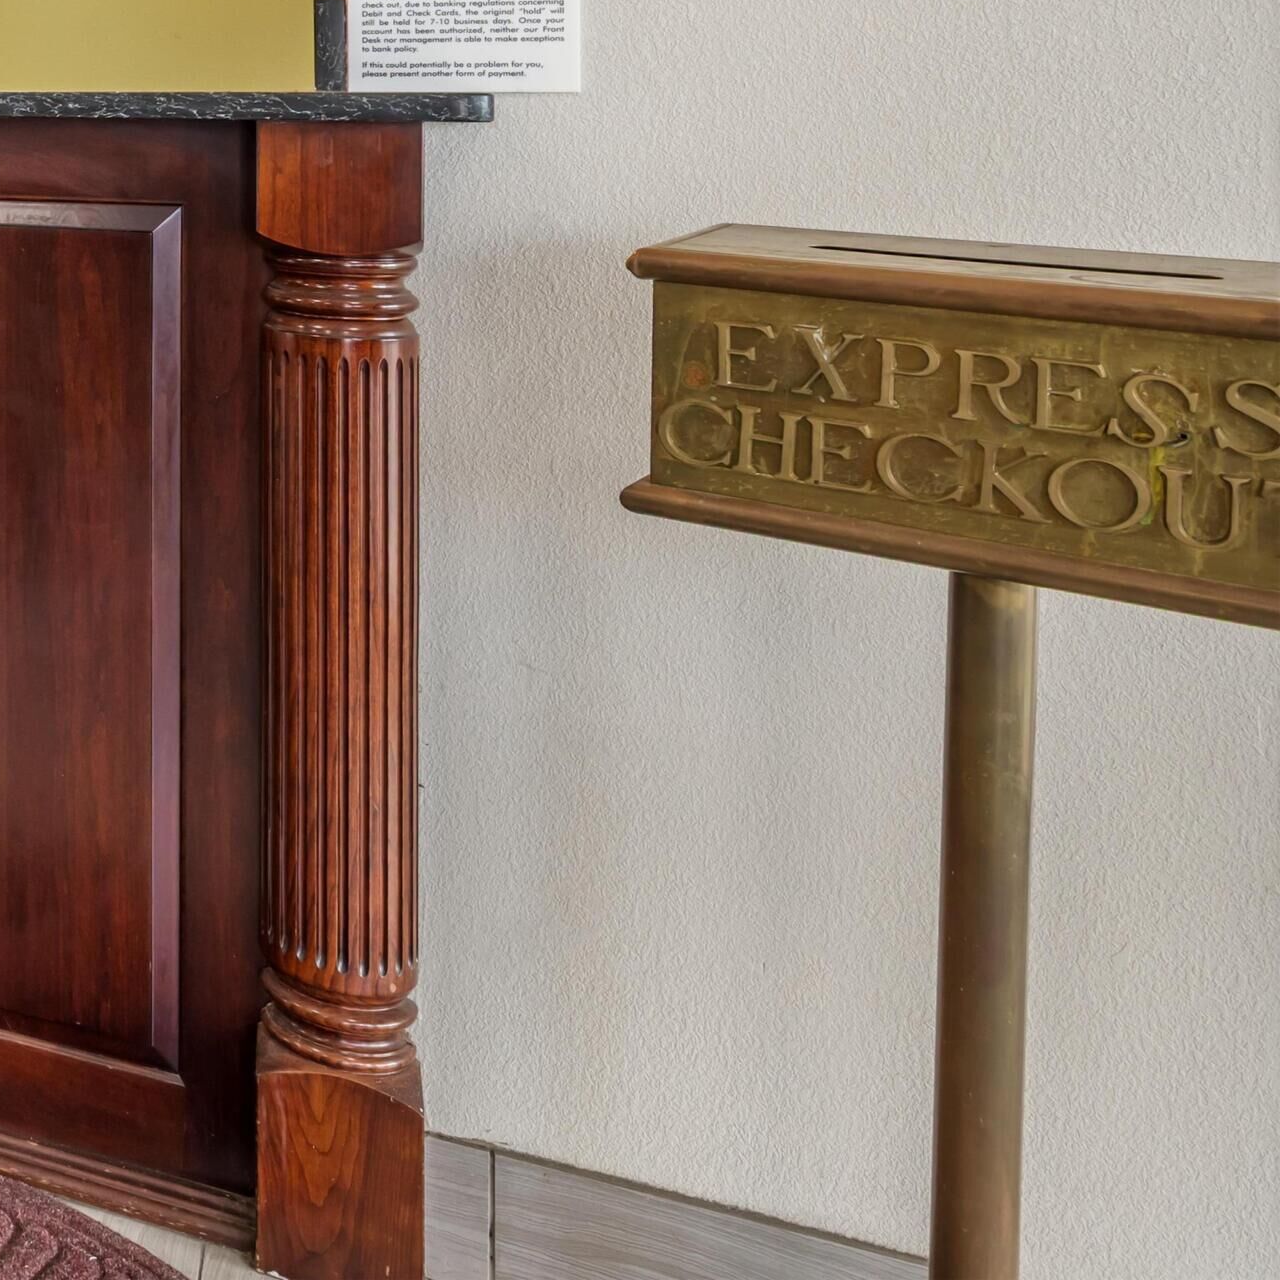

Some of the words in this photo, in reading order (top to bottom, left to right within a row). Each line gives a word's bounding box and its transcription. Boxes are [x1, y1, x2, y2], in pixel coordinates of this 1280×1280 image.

[482, 8, 515, 17] original
[410, 61, 452, 70] potentially
[474, 61, 509, 70] problem
[362, 70, 388, 79] please
[390, 70, 420, 79] present
[713, 320, 1280, 462] EXPRESS
[657, 401, 1280, 551] CHECKOU
